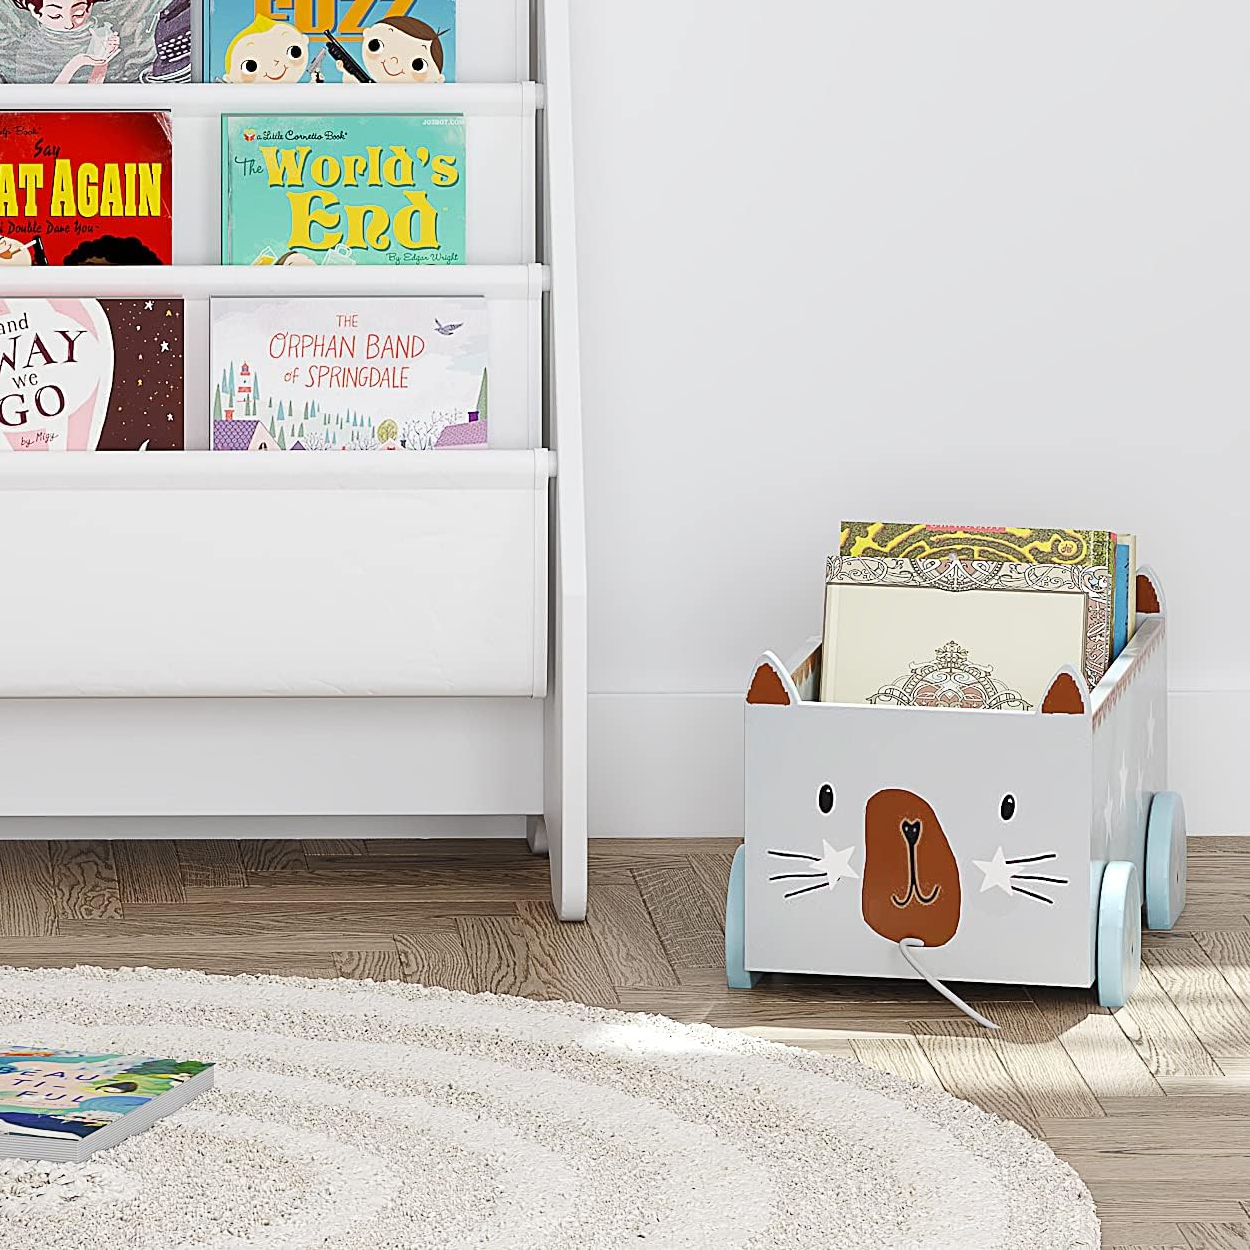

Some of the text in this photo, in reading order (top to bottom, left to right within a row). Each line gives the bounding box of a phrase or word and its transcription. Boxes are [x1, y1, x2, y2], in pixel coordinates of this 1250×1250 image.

[263, 130, 284, 140] Little
[285, 129, 323, 141] Cornetto
[34, 138, 61, 158] Say
[235, 156, 264, 176] The
[50, 158, 162, 218] AGAIN
[8, 221, 42, 234] Double
[46, 220, 70, 234] Dare
[286, 189, 441, 251] End
[386, 252, 459, 265] By Edgar Wright
[336, 314, 358, 328] THE
[269, 332, 425, 359] ORPHAN BAND
[11, 372, 38, 389] we
[284, 365, 409, 388] of SPRINGDALE
[20, 432, 59, 448] by Migy
[16, 1090, 84, 1103] FUL
